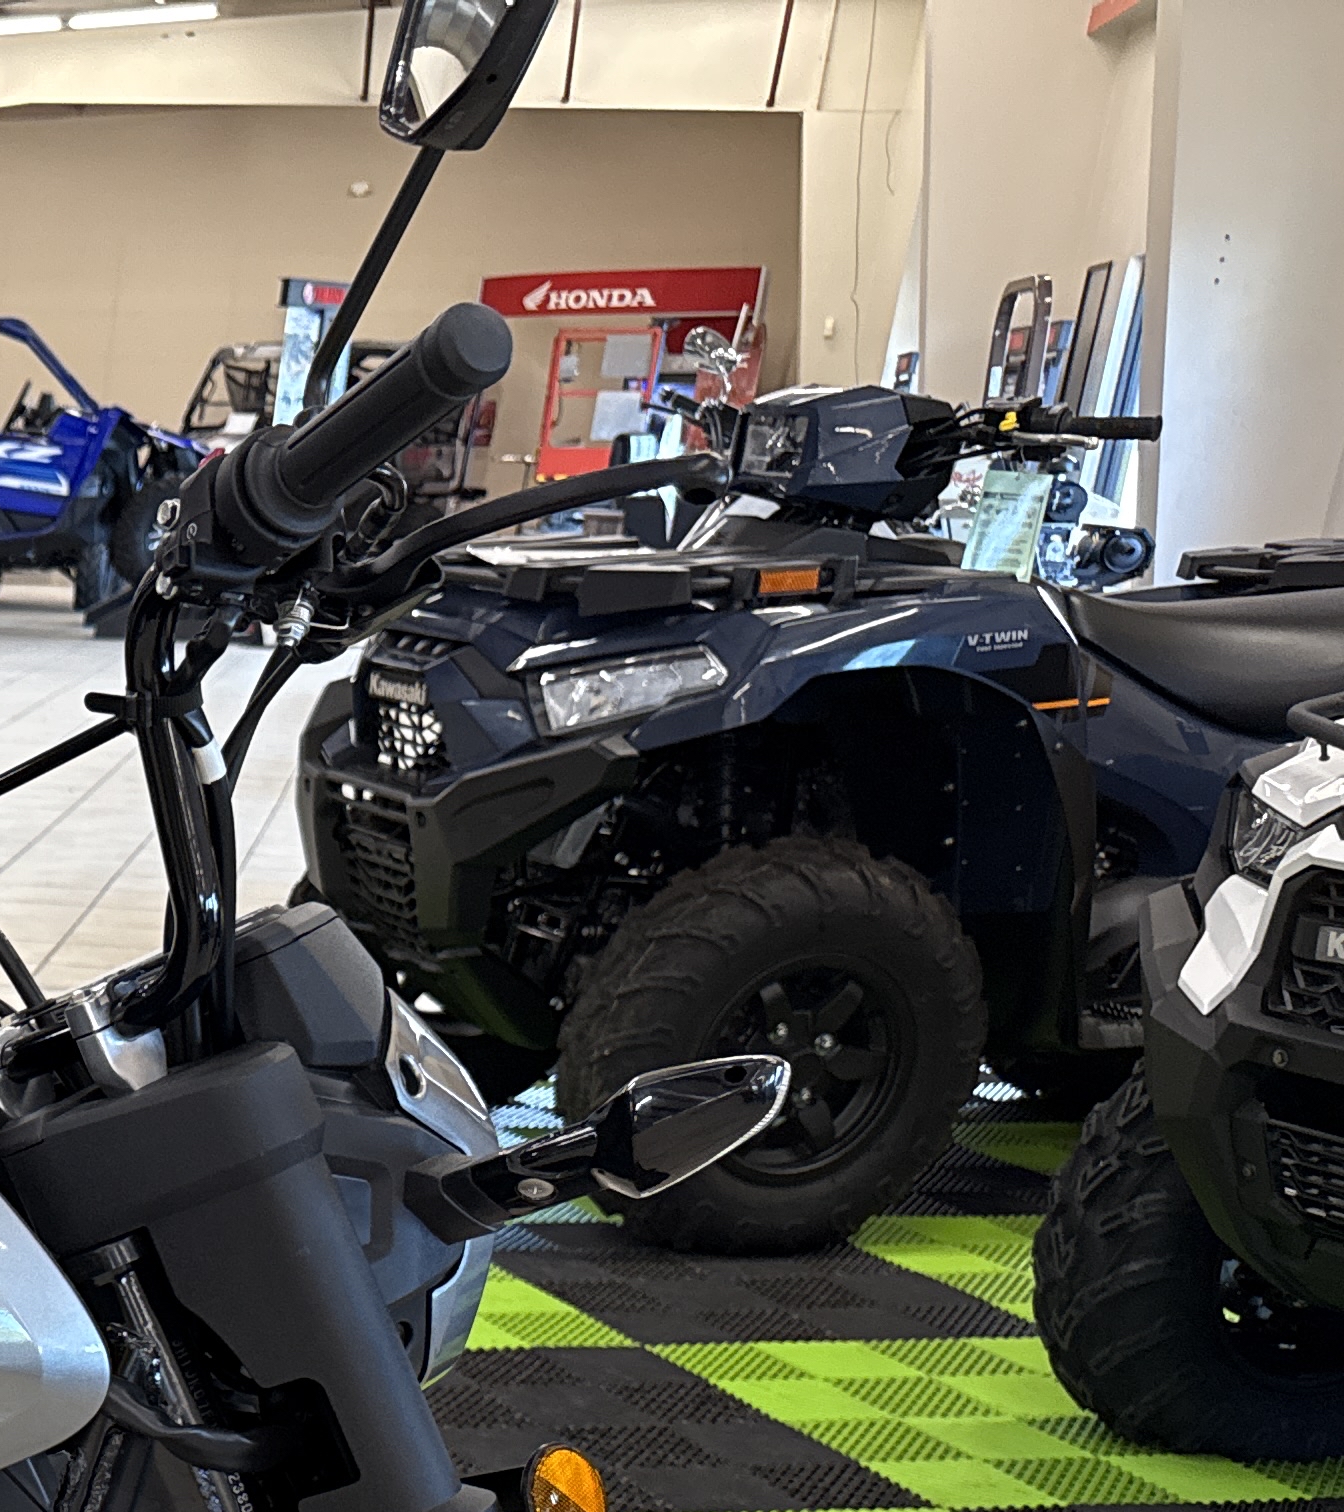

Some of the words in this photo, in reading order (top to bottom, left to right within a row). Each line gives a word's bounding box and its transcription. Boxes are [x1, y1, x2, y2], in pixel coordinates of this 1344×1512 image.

[546, 286, 657, 311] HONDA
[967, 628, 1029, 647] V-TWIN
[369, 671, 427, 707] Kawasaki
